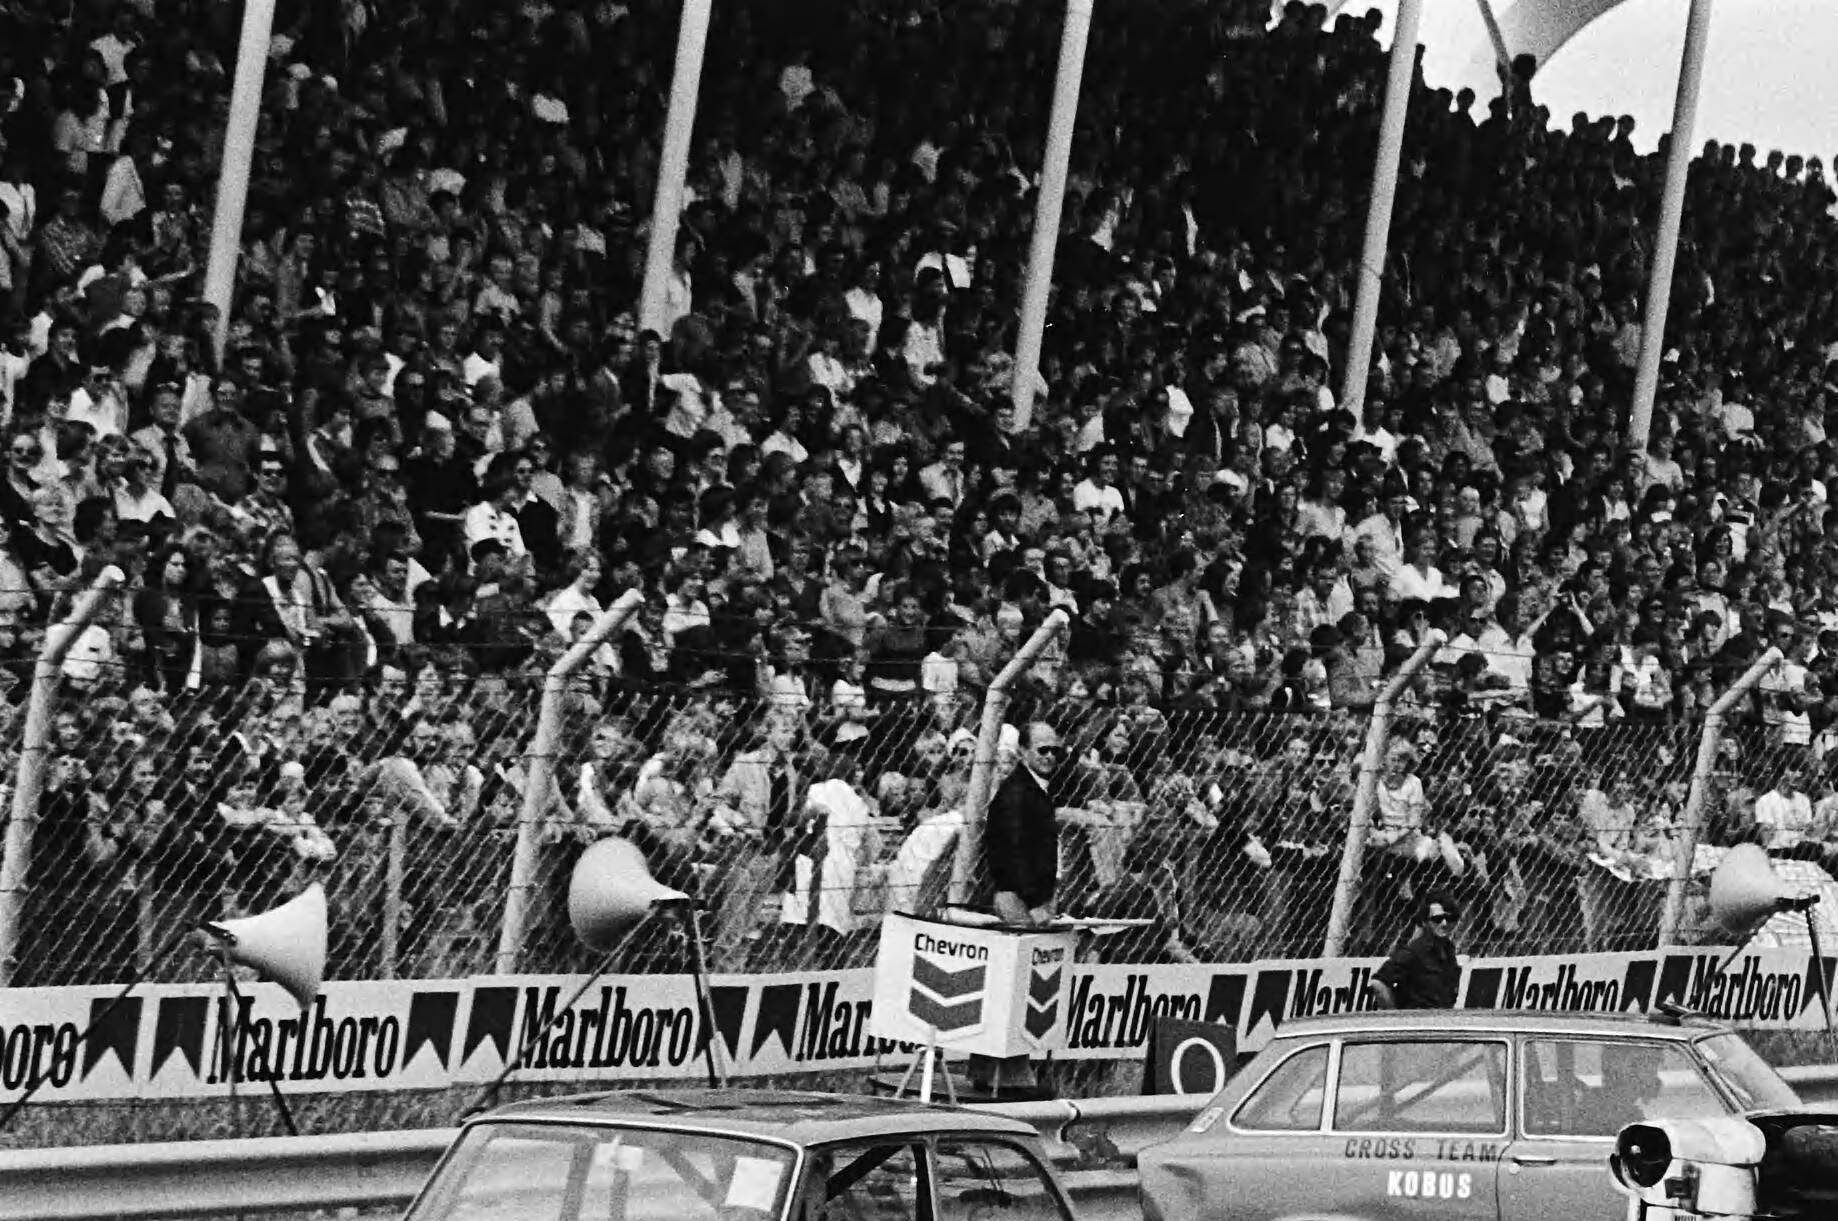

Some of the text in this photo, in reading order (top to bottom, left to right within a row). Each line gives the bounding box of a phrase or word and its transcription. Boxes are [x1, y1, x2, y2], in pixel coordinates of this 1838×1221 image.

[914, 932, 989, 961] Chevron
[1686, 953, 1801, 1020] Marlboro
[206, 993, 400, 1084] Marlboro
[514, 985, 694, 1069] Marlboro
[1345, 1137, 1498, 1163] CROSS TEAM
[1386, 1170, 1473, 1199] KOBUS
